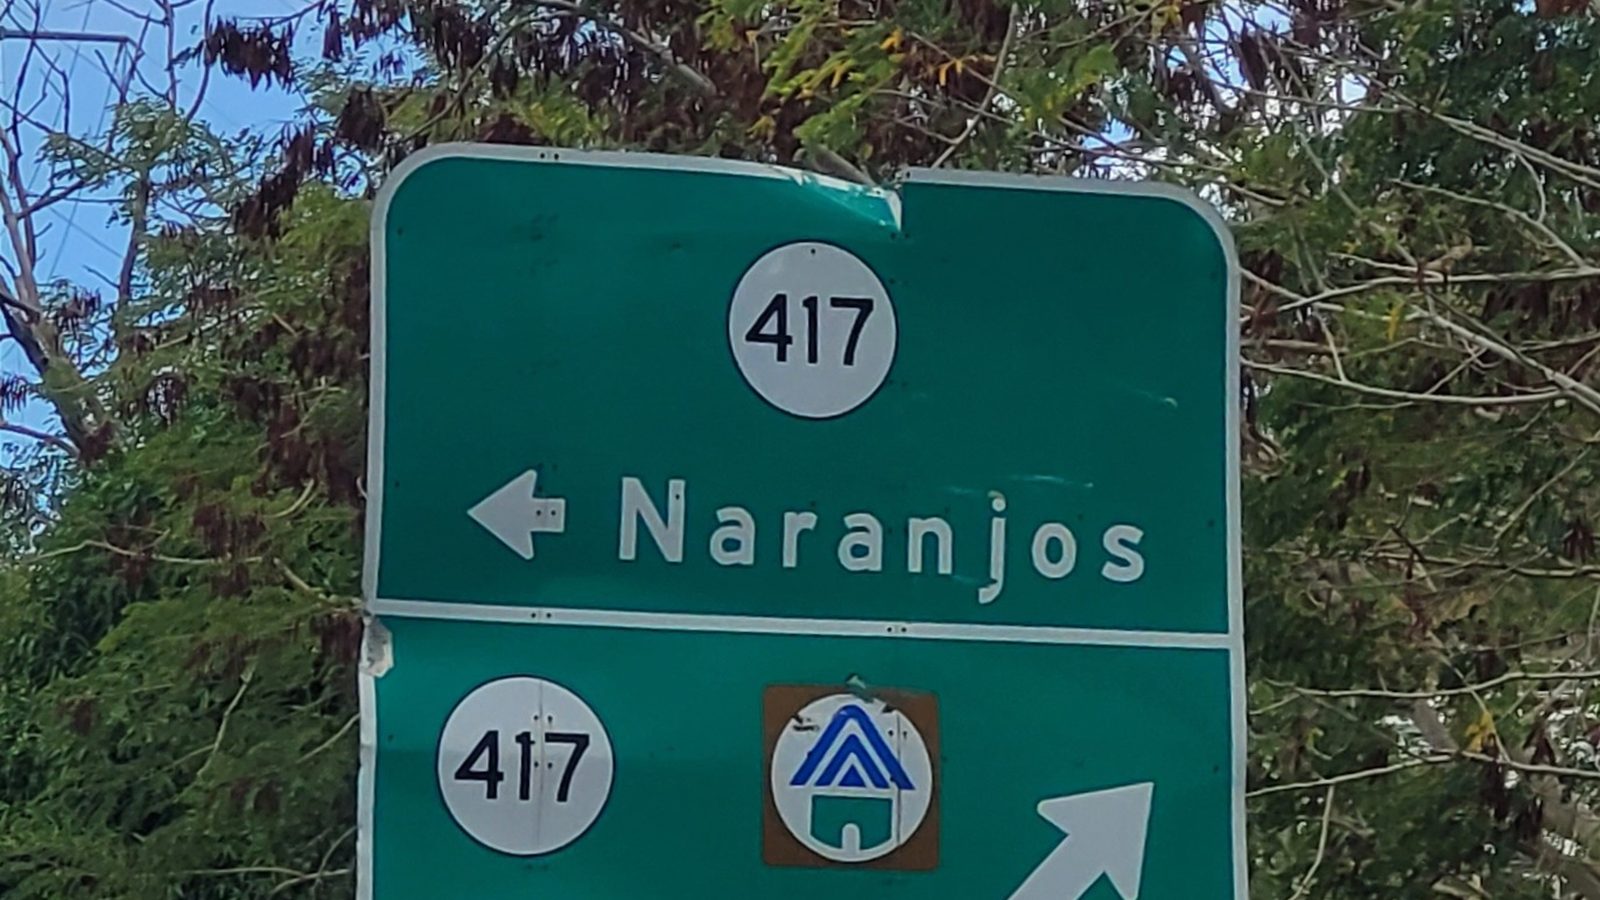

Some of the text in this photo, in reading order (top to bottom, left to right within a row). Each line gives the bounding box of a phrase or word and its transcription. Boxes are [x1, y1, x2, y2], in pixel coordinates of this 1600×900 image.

[745, 293, 874, 366] 417
[619, 476, 1145, 604] Naranjos
[454, 730, 590, 803] 417
